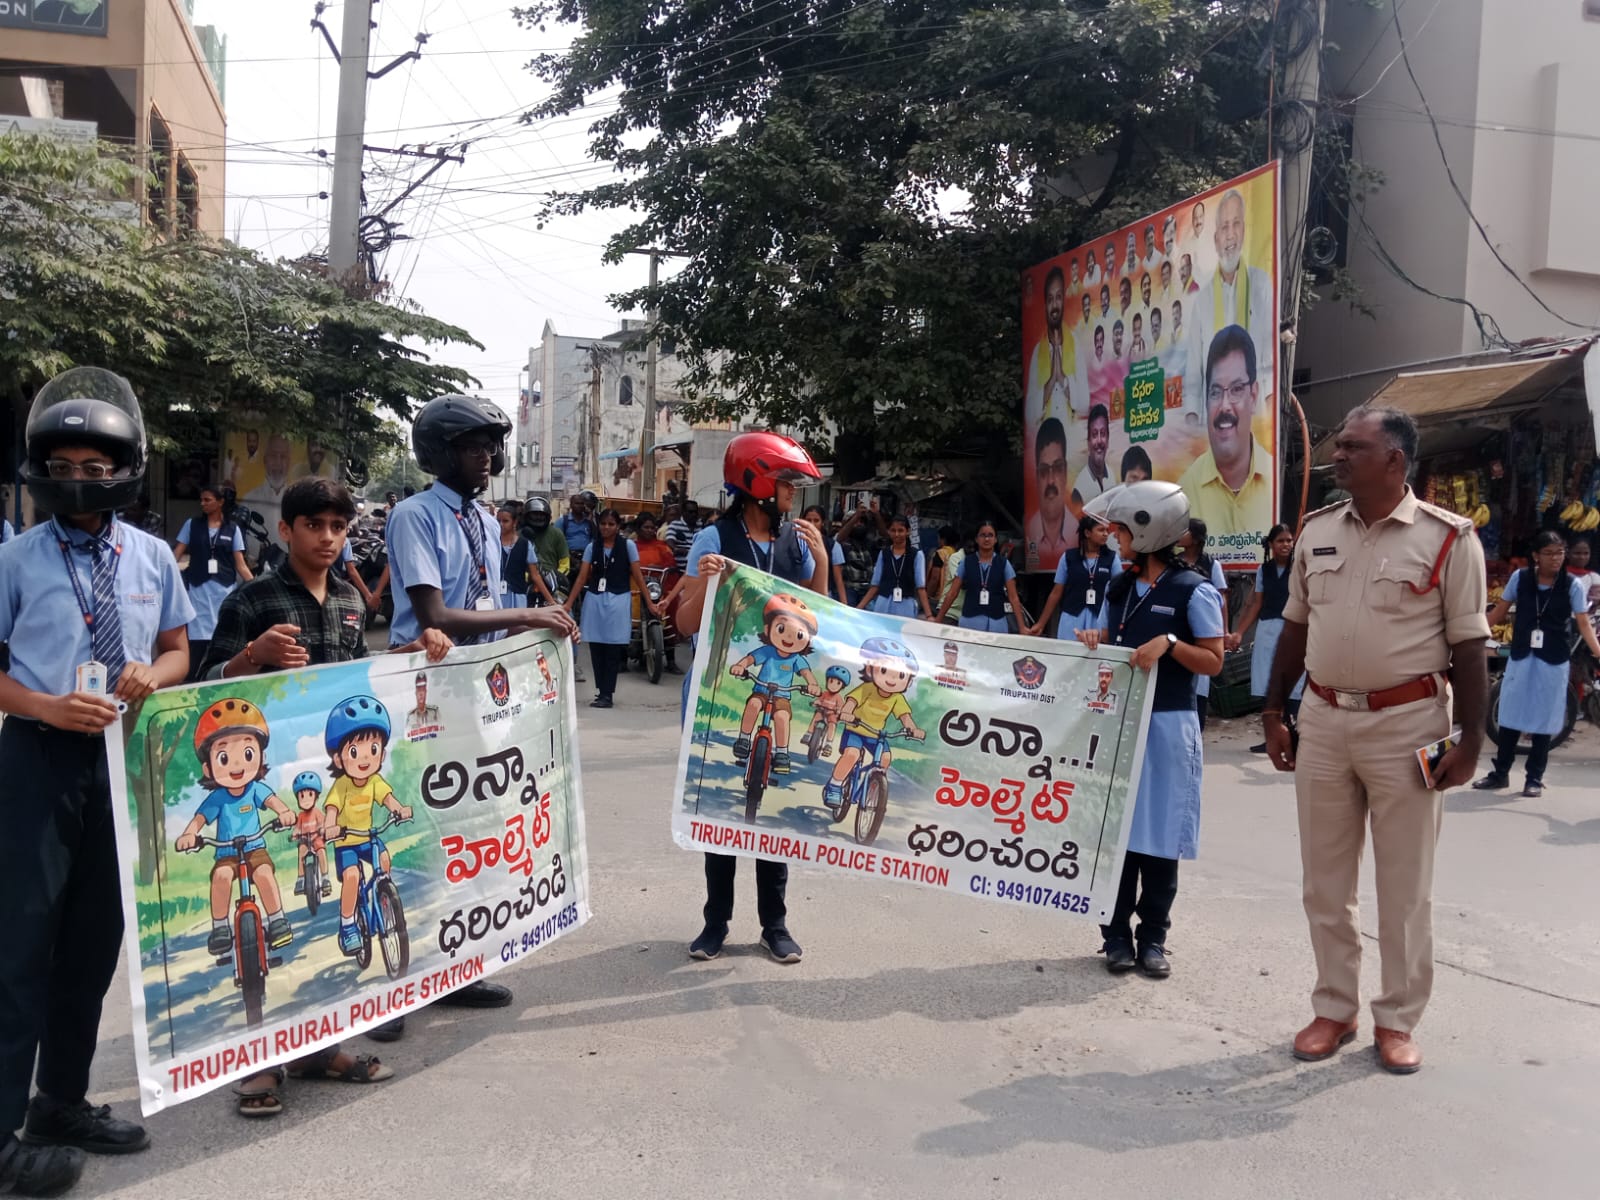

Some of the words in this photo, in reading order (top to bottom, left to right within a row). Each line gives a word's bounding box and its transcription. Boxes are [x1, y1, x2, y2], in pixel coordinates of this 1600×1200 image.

[481, 709, 511, 726] TIRUPATHI
[511, 703, 522, 718] DIST
[1000, 687, 1039, 702] TIRUPATHI
[1039, 693, 1056, 704] DIST
[935, 767, 1075, 835] హెల్మెట్
[441, 791, 551, 884] హెల్మెట్
[690, 821, 755, 851] TIRUPATI
[759, 833, 811, 861] RURAL
[815, 843, 876, 873] POLICE
[881, 857, 950, 887] STATION
[907, 824, 1080, 880] ధరించండి
[438, 853, 567, 959] ధరించండి
[970, 874, 991, 896] CI:
[996, 879, 1091, 915] 9491074525
[521, 901, 579, 953] 9491074525
[168, 1037, 269, 1093] TIRUPATI
[274, 1014, 344, 1054] RURAL
[349, 985, 415, 1029] POLICE
[419, 953, 485, 1000] STATION
